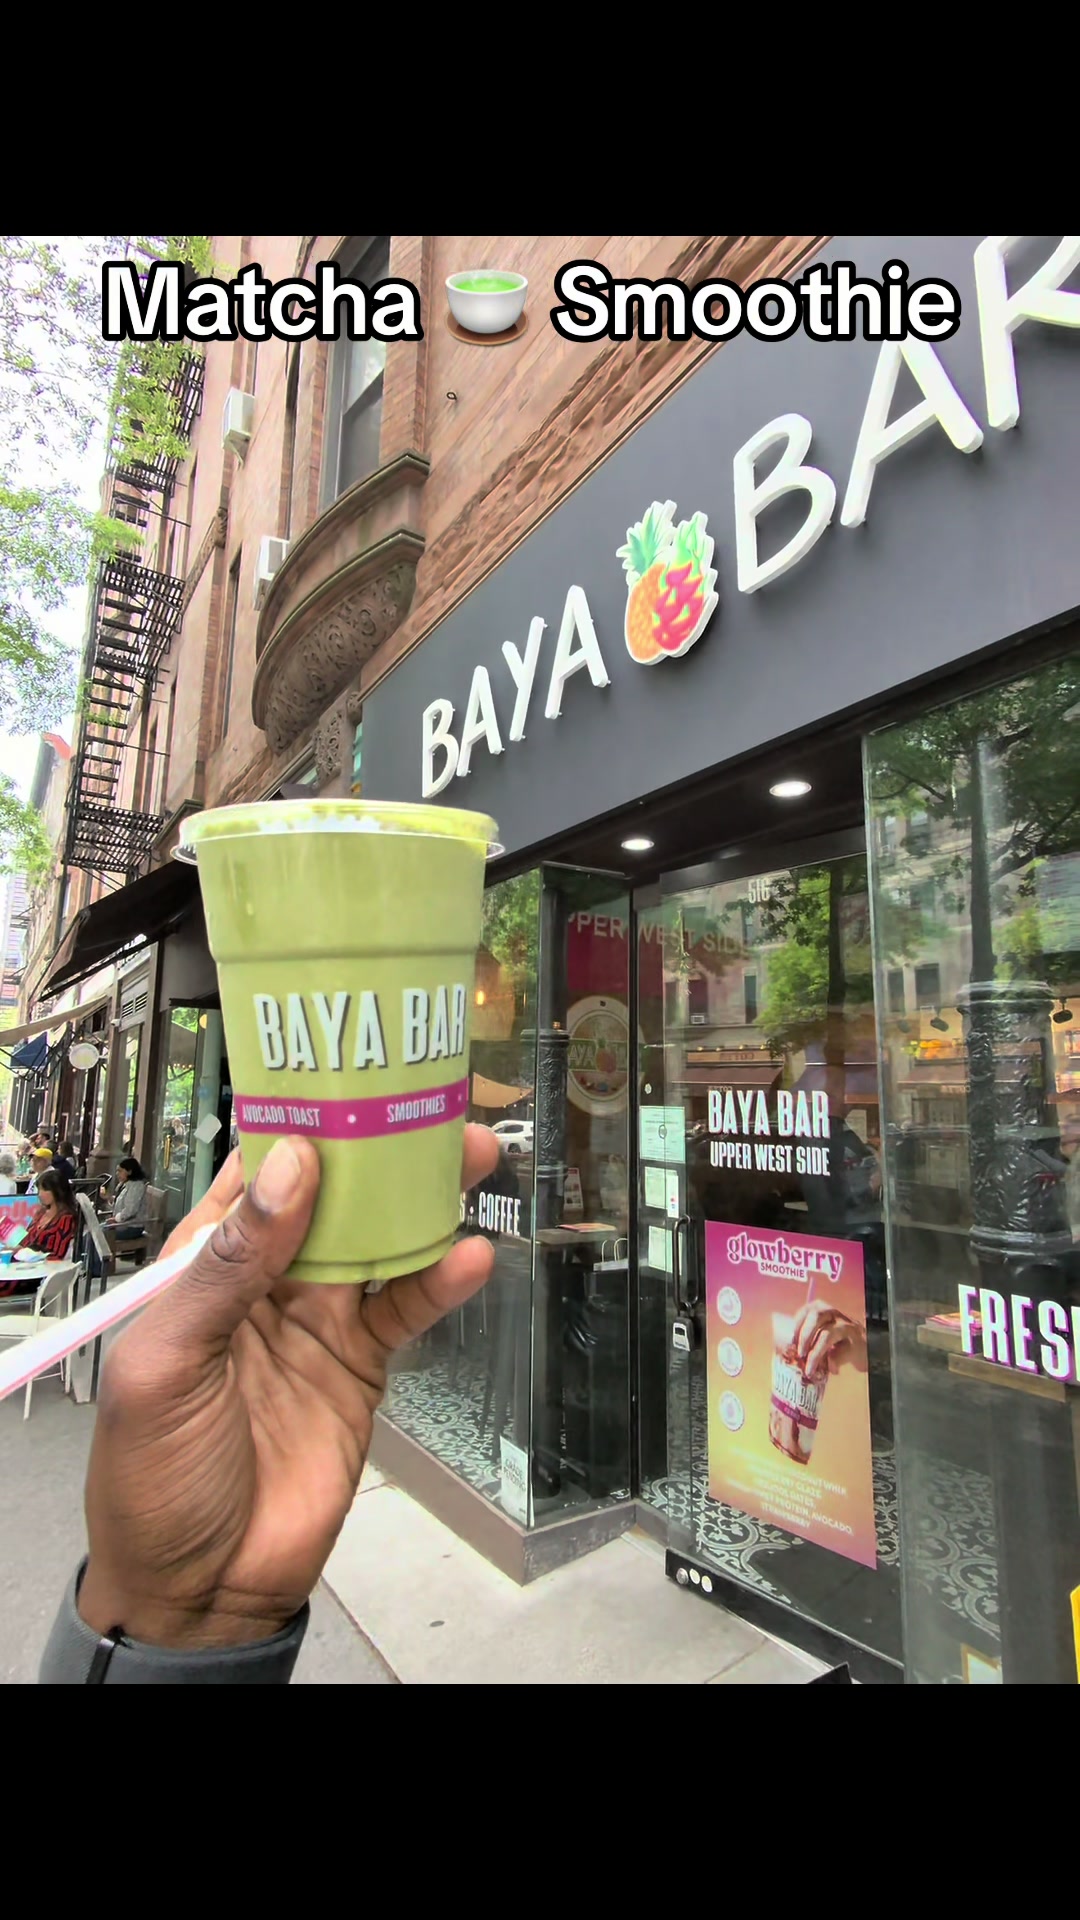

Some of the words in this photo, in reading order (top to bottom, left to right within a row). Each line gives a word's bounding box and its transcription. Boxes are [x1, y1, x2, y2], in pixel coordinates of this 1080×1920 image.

[422, 584, 609, 798] BAYA
[733, 236, 1080, 594] BAR
[253, 990, 387, 1071] BAYA
[402, 983, 466, 1065] BAR
[242, 1103, 286, 1123] AVOCADO
[288, 1106, 320, 1128] TOAST
[387, 1094, 446, 1123] SMOOTHIES
[708, 1089, 771, 1136] BAYA
[777, 1090, 831, 1138] BAR
[710, 1140, 751, 1170] UPPER
[754, 1143, 793, 1174] WEST
[796, 1145, 831, 1177] SIDE
[478, 1191, 521, 1237] COFFEE
[728, 1233, 841, 1280] glowberry
[760, 1262, 805, 1278] SMOOTHIE
